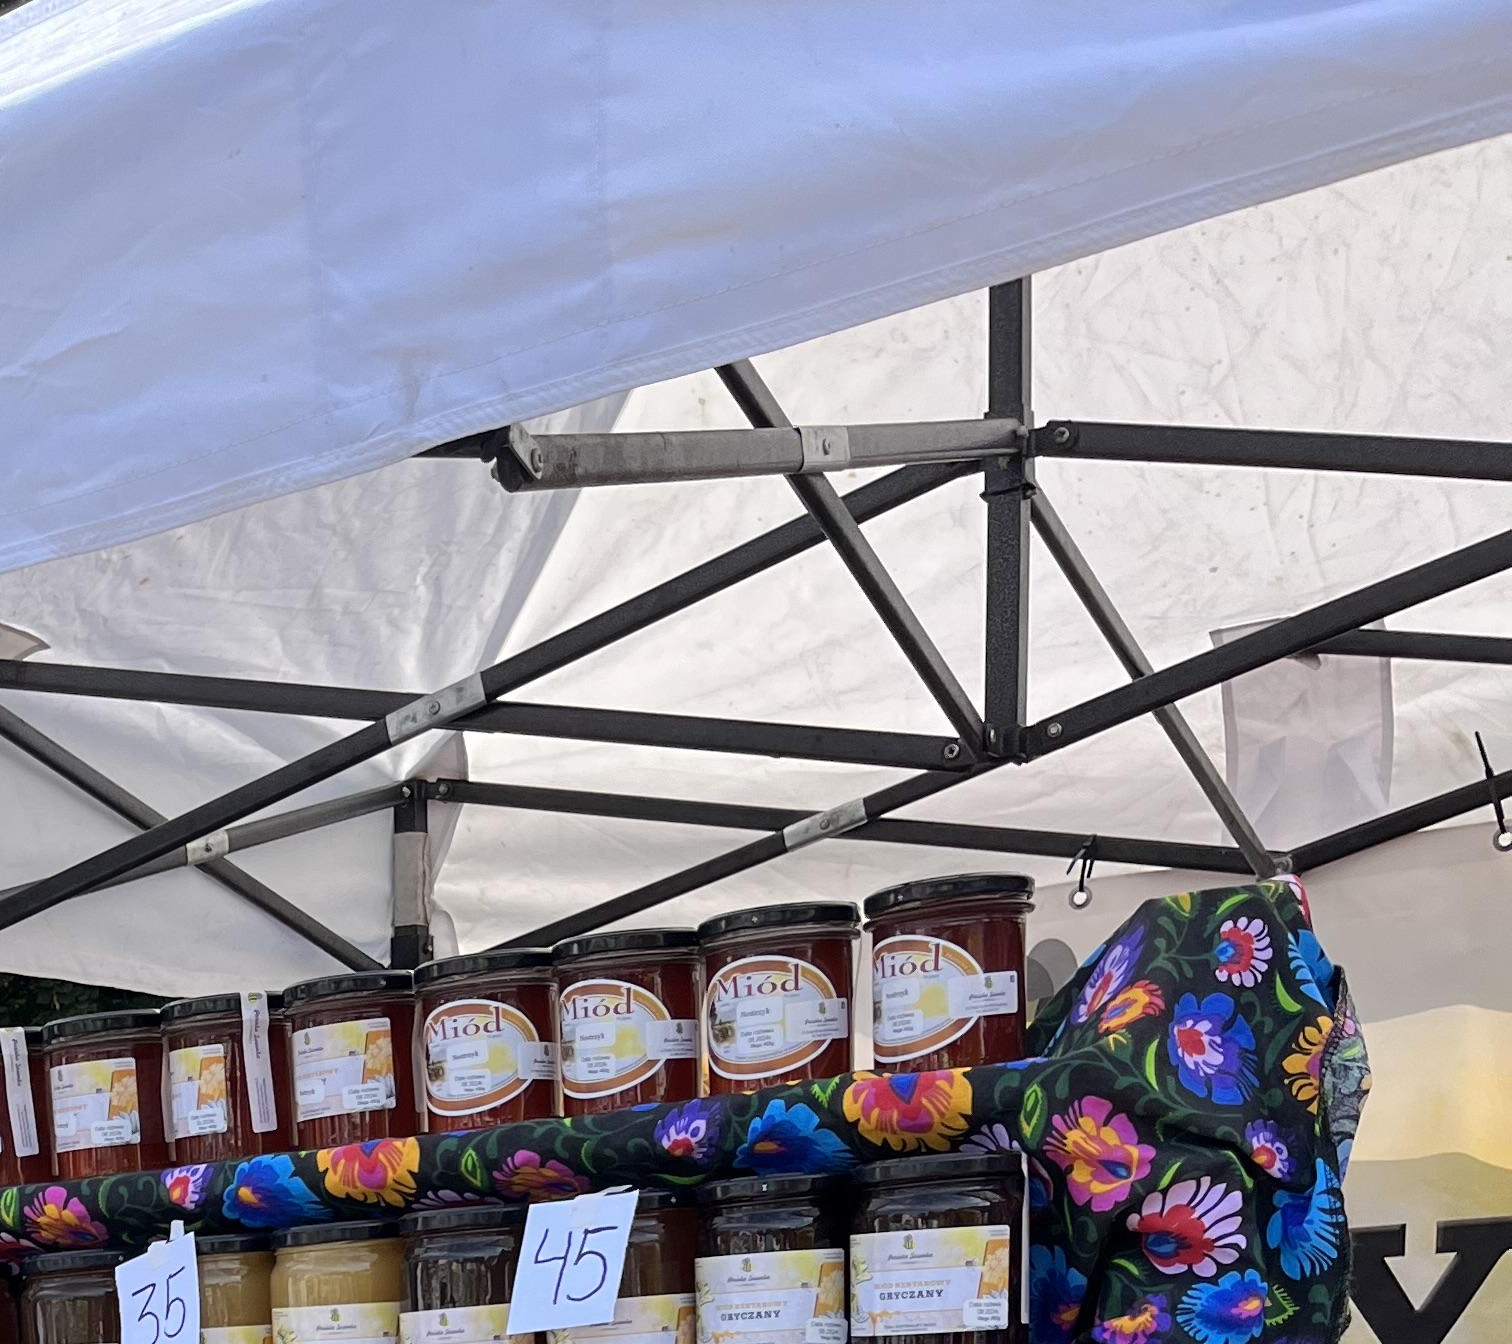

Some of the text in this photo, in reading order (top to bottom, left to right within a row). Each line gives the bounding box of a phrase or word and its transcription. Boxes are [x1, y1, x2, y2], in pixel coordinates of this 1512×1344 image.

[873, 943, 943, 982] Miód
[716, 963, 804, 1002] Miód
[561, 987, 635, 1021] Miód
[428, 1006, 504, 1044] Miód
[534, 1225, 619, 1306] 45
[879, 1289, 944, 1302] GRYCZANY
[720, 1309, 781, 1322] GRYCZANY
